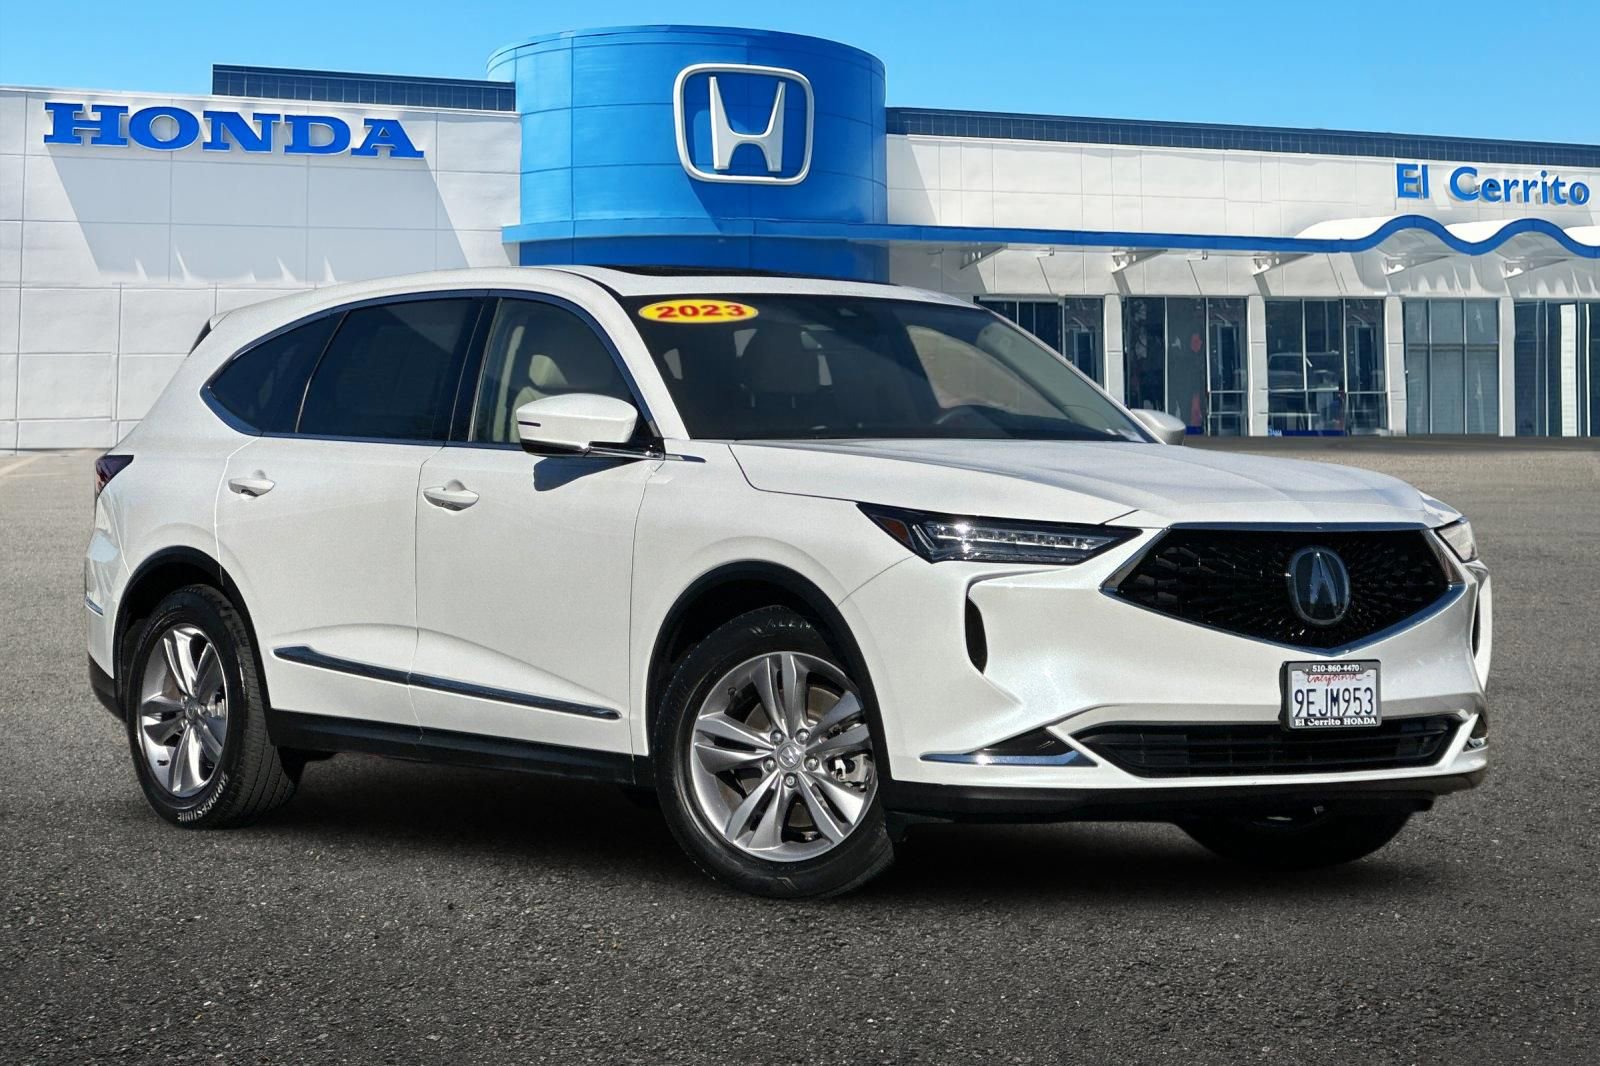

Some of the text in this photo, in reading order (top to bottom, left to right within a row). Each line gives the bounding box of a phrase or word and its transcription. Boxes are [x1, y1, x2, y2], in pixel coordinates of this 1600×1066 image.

[44, 101, 425, 159] HONDA
[1395, 162, 1591, 206] El Cerrito
[655, 304, 746, 319] 2023
[1312, 664, 1360, 672] 510-860-4470
[1294, 687, 1374, 718] 9EJM953
[1295, 717, 1377, 726] El Cerrito HONDA
